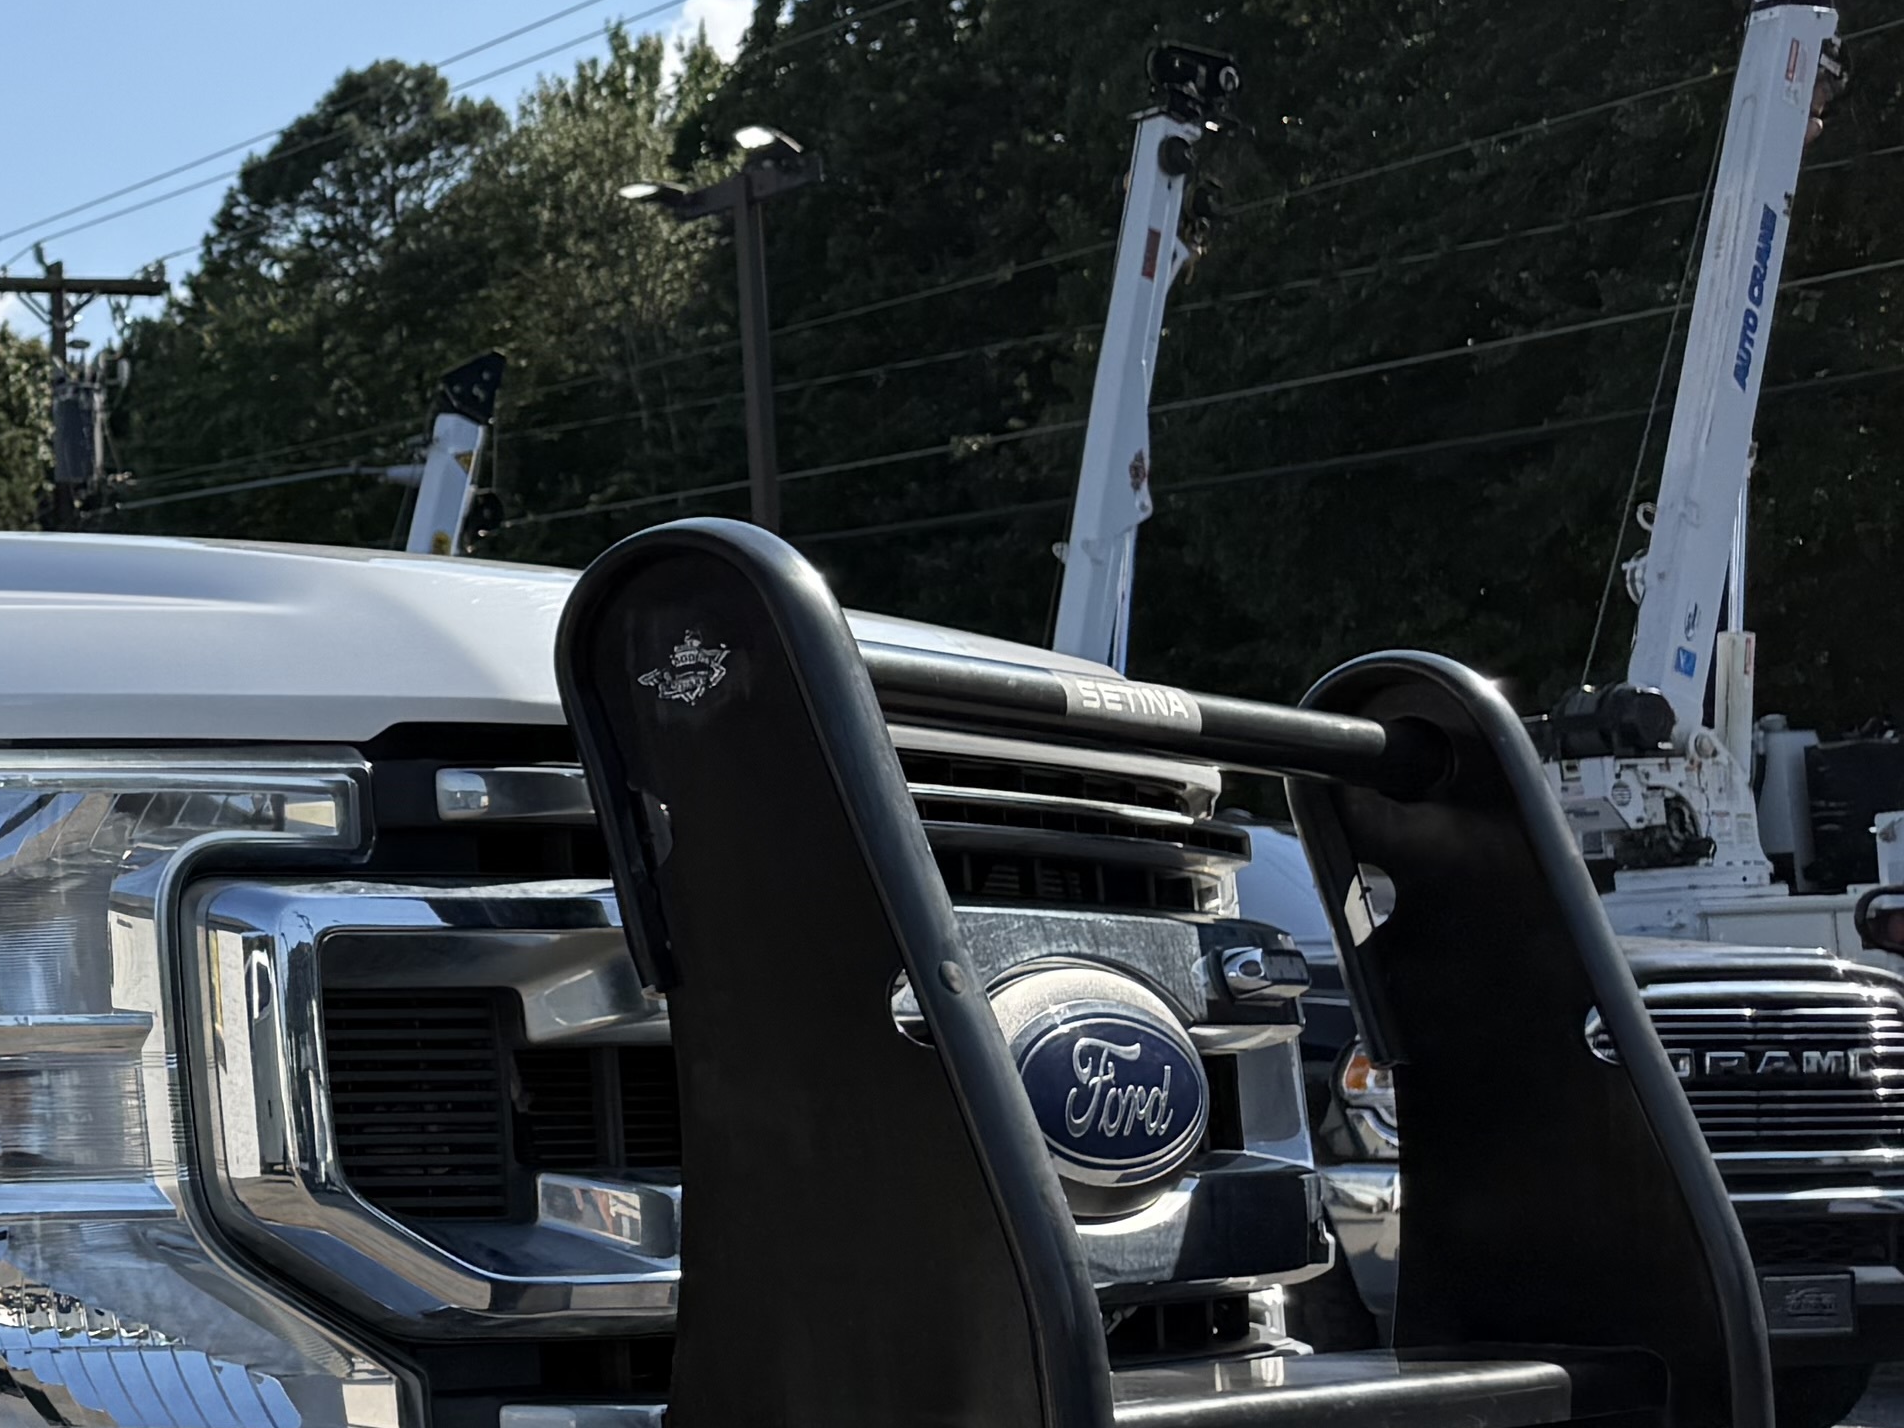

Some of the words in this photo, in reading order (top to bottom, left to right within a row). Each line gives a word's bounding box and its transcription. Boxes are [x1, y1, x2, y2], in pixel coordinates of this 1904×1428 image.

[1733, 307, 1759, 393] AUTO
[1075, 678, 1189, 719] SETINA
[1065, 1036, 1174, 1138] Ford
[1704, 1050, 1847, 1075] RAM
